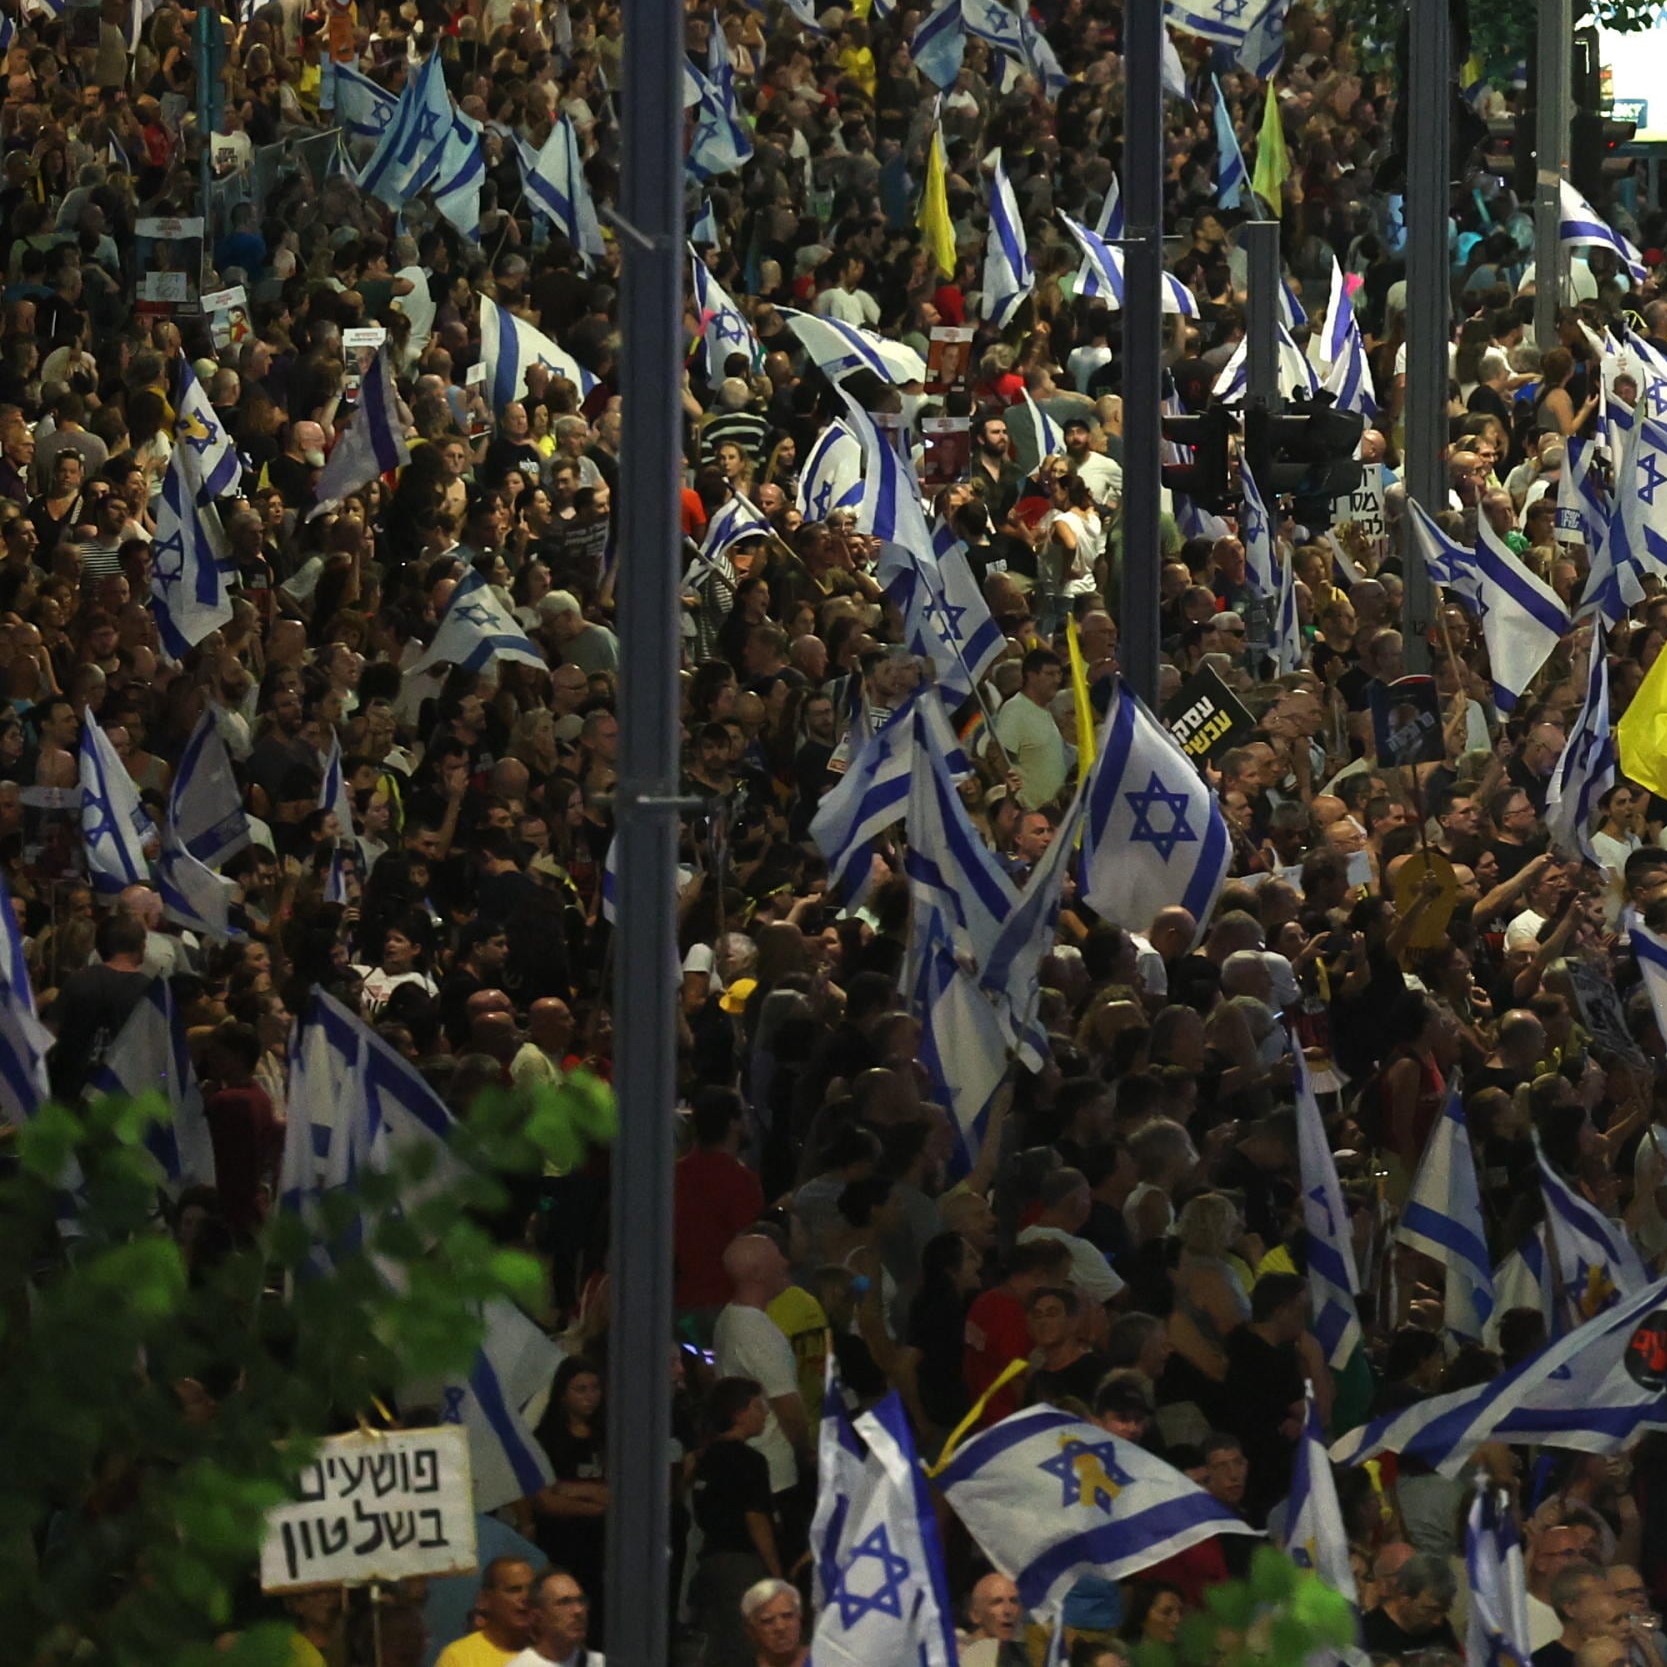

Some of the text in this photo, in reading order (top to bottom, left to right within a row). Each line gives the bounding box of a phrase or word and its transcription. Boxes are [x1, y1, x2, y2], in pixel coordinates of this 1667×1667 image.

[1171, 695, 1215, 745] עסק
[1183, 709, 1233, 756] עכשי
[299, 1446, 439, 1501] פושעים
[281, 1498, 449, 1580] בשלטון
